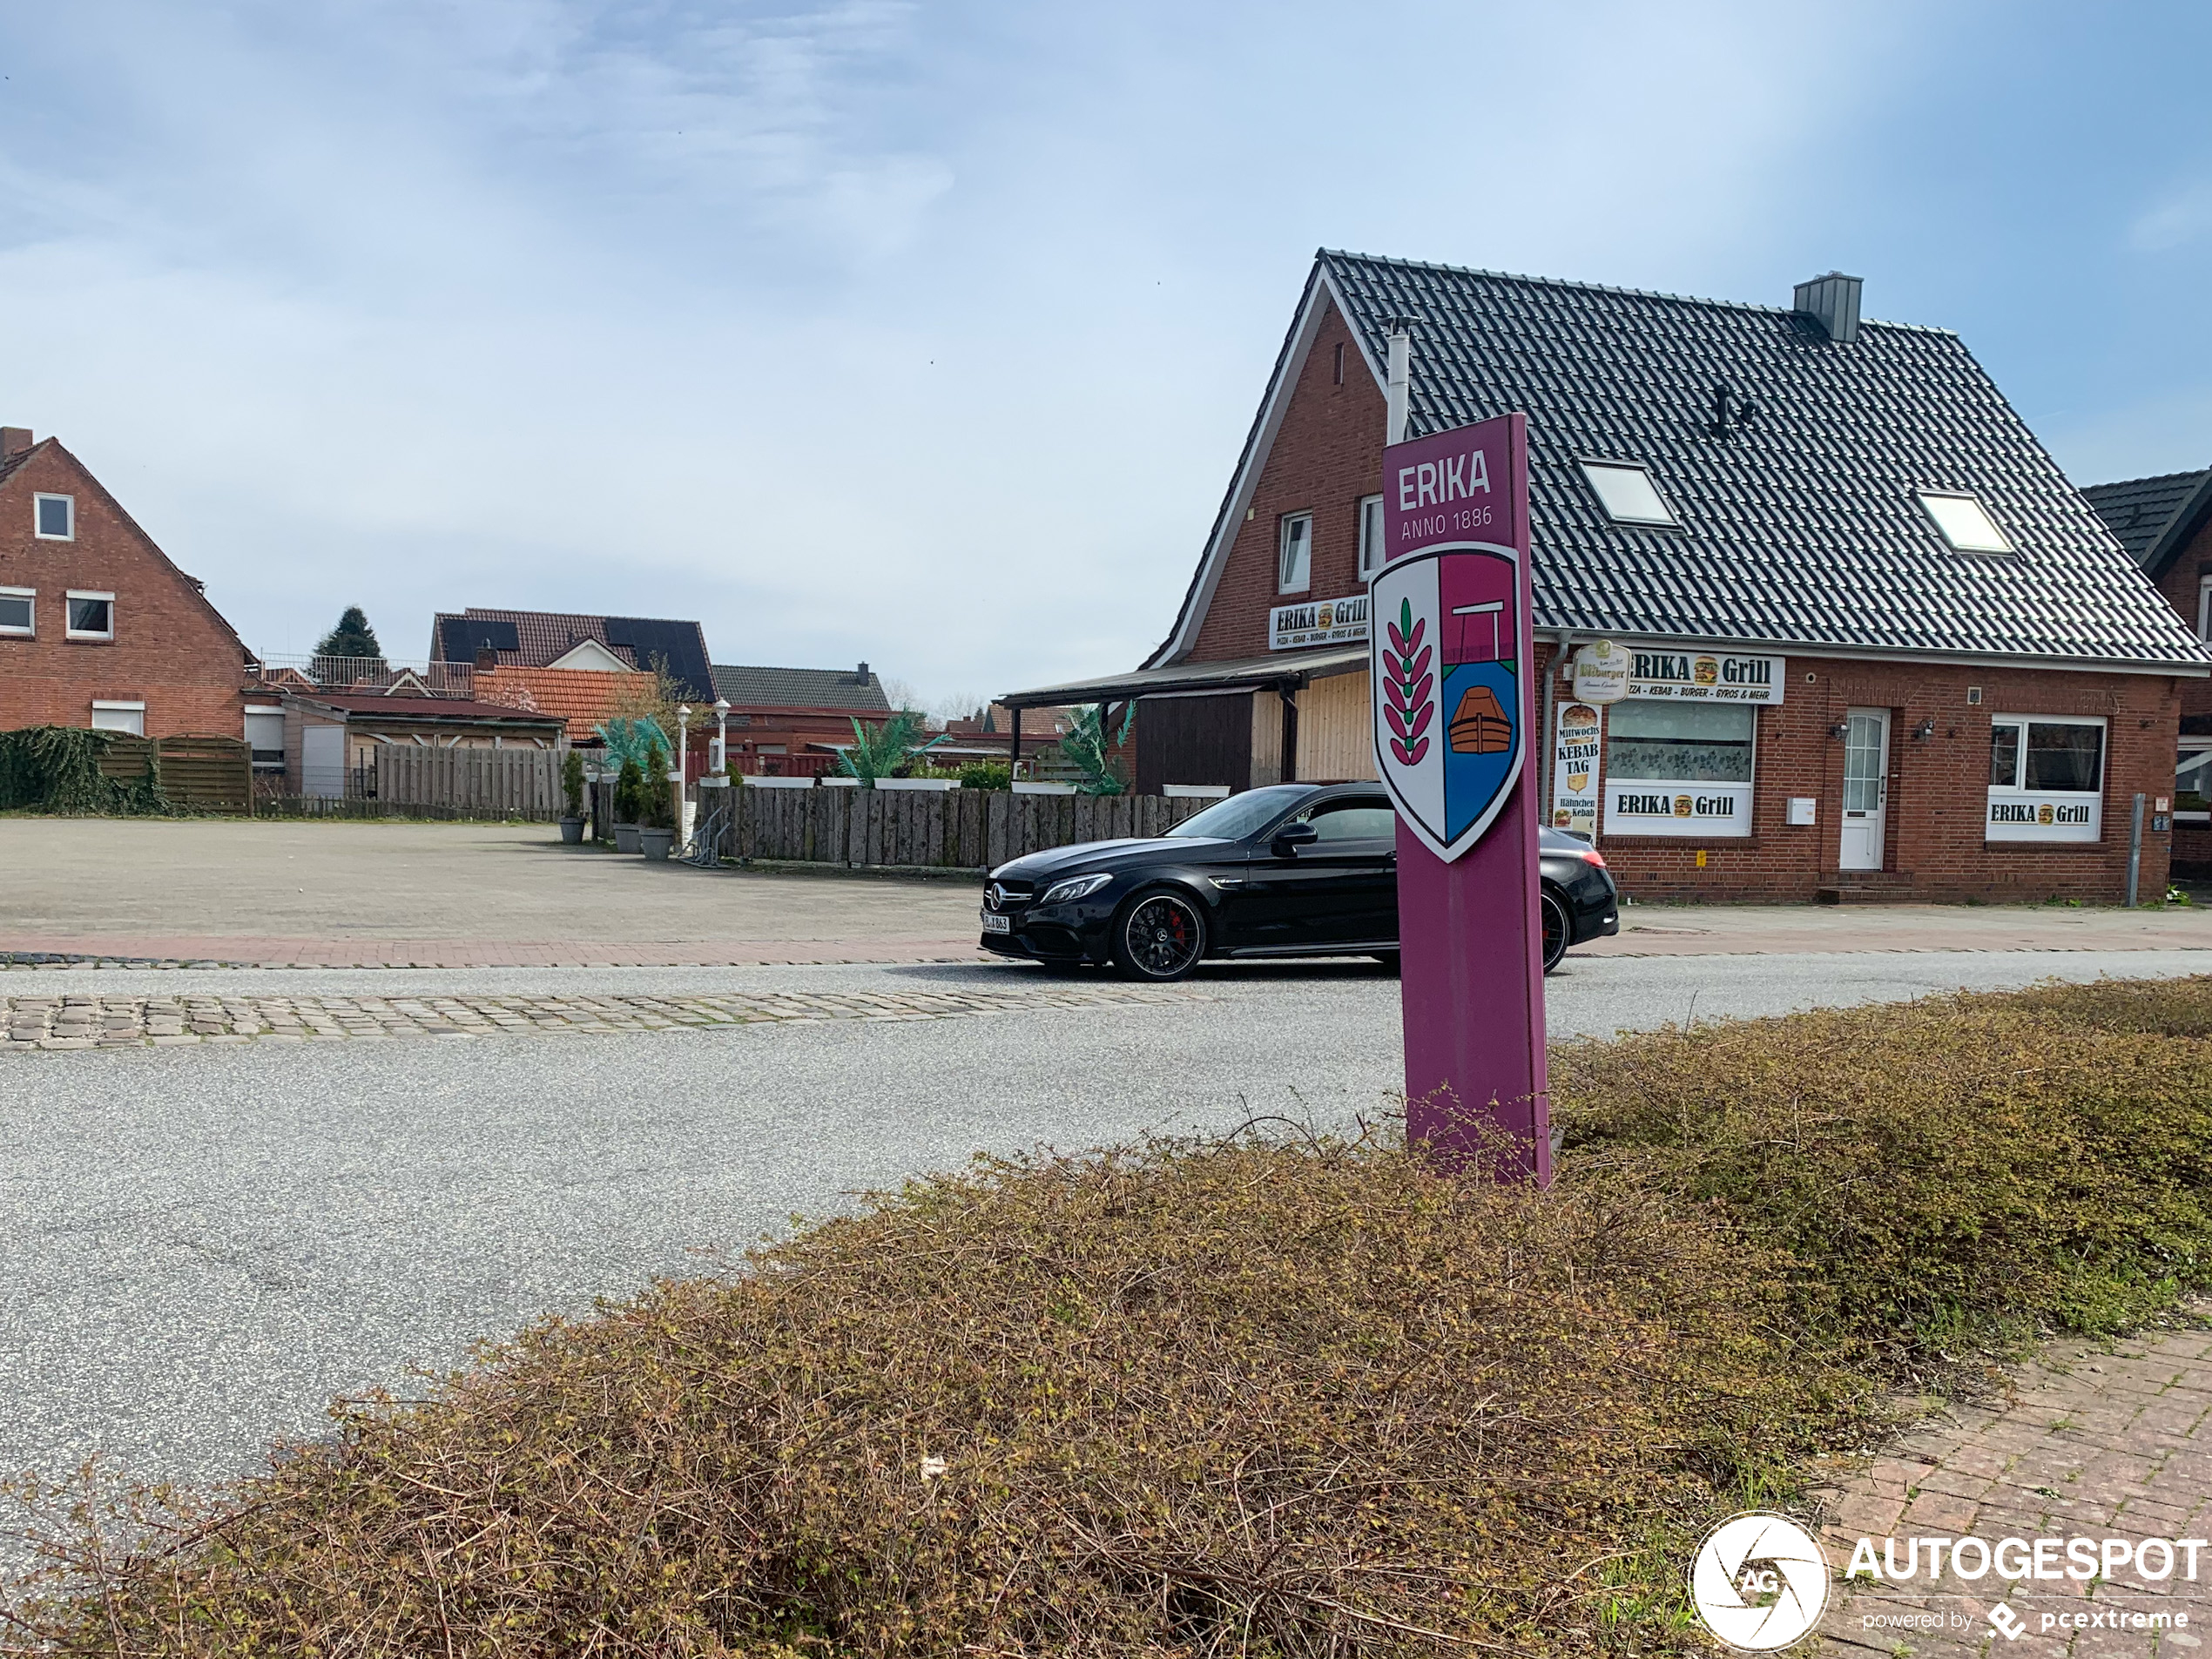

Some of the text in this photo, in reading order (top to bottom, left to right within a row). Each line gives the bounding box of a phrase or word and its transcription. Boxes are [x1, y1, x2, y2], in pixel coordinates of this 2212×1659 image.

[1399, 449, 1491, 512] ERIKA
[1401, 506, 1492, 540] ANNO 1886
[1277, 599, 1368, 631] ERIKA Grill
[1277, 637, 1289, 645] PIZZA
[1722, 658, 1770, 684] Grill
[1629, 685, 1641, 694] ZZA
[1649, 685, 1673, 696] KEBAB
[1680, 687, 1708, 698] BURGER
[1716, 689, 1739, 699] GYROS
[1740, 691, 1748, 699] &
[1749, 691, 1770, 700] MEHR
[1559, 726, 1600, 738] Mittwochs
[1558, 744, 1599, 760] KEBAB
[1566, 759, 1589, 774] TAG
[1560, 798, 1595, 807] Hähnchen
[1617, 794, 1734, 815] ERIKA Grill
[1572, 808, 1595, 817] Kebab
[1991, 804, 2089, 823] ERIKA Grill
[995, 917, 1007, 929] 863
